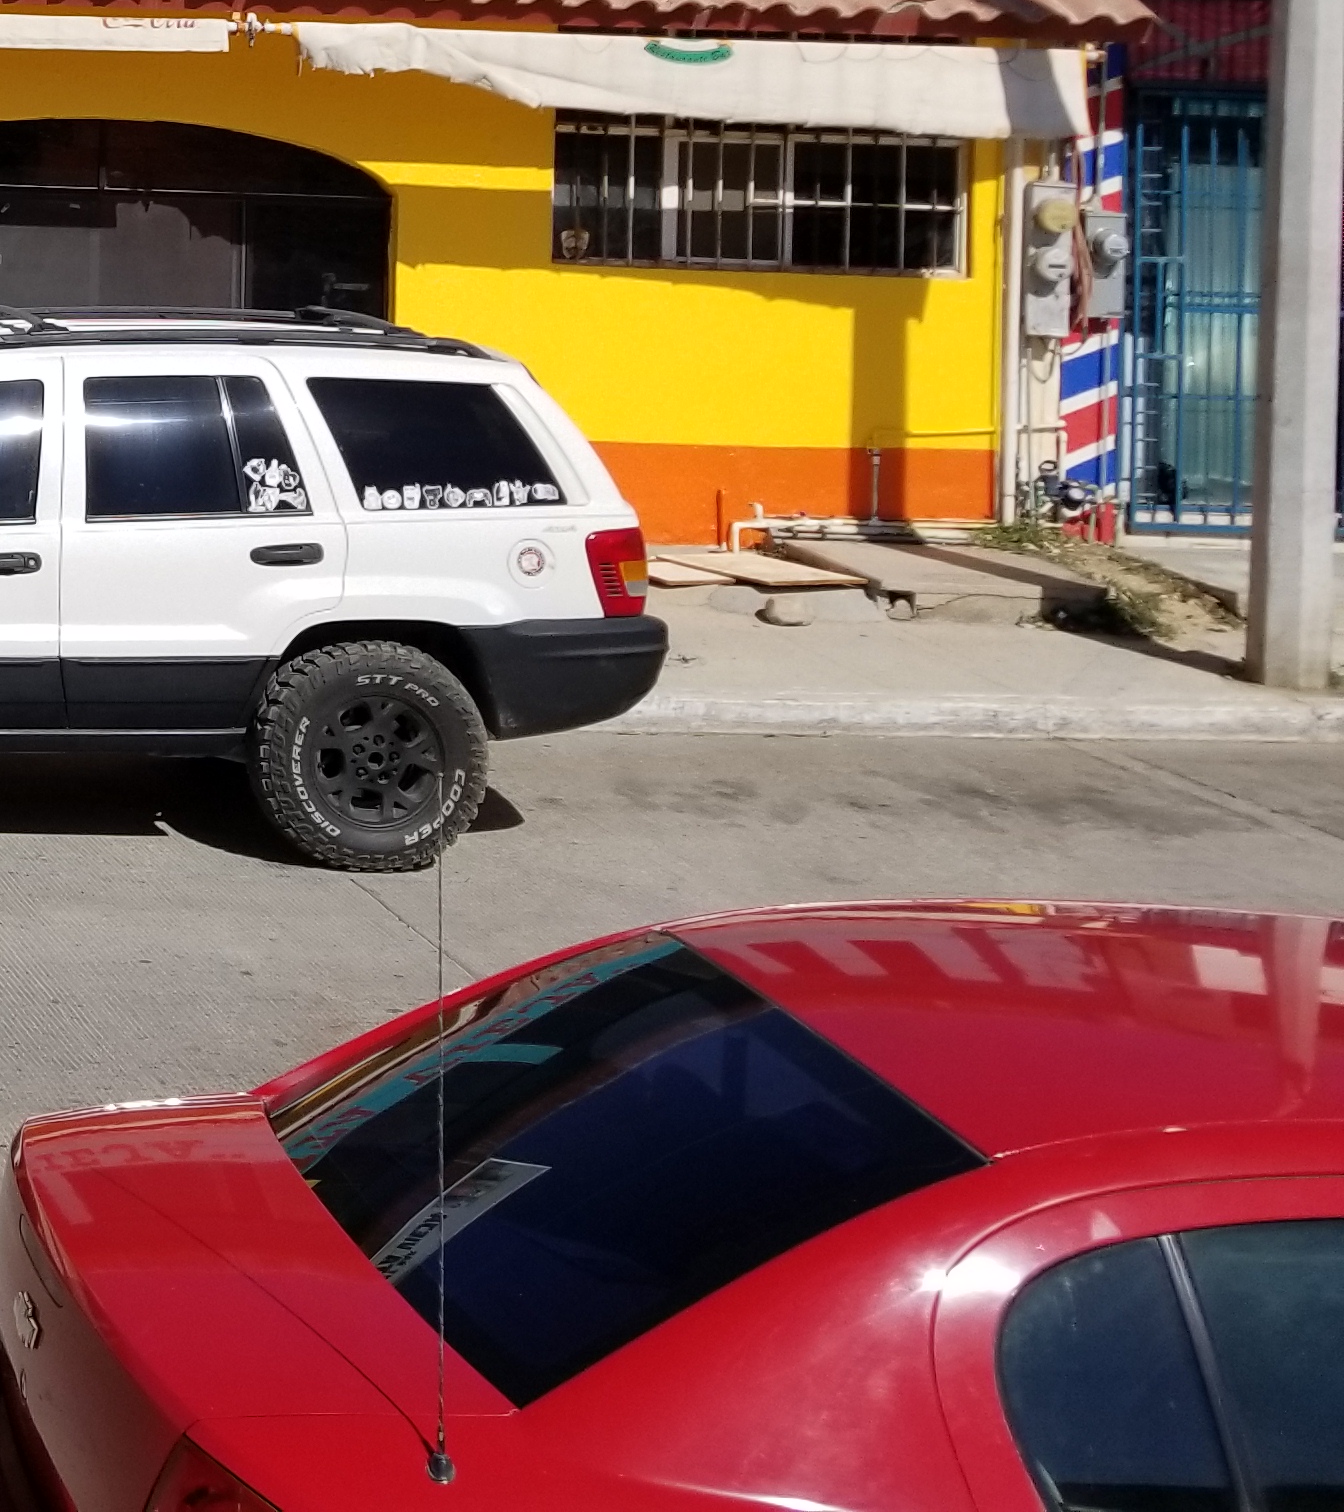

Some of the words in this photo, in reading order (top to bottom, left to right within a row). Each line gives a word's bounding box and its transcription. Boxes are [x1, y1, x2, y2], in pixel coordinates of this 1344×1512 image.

[356, 674, 404, 687] STT
[405, 683, 440, 707] PRO
[291, 716, 341, 838] DISCOVERER
[404, 769, 466, 846] COOPER
